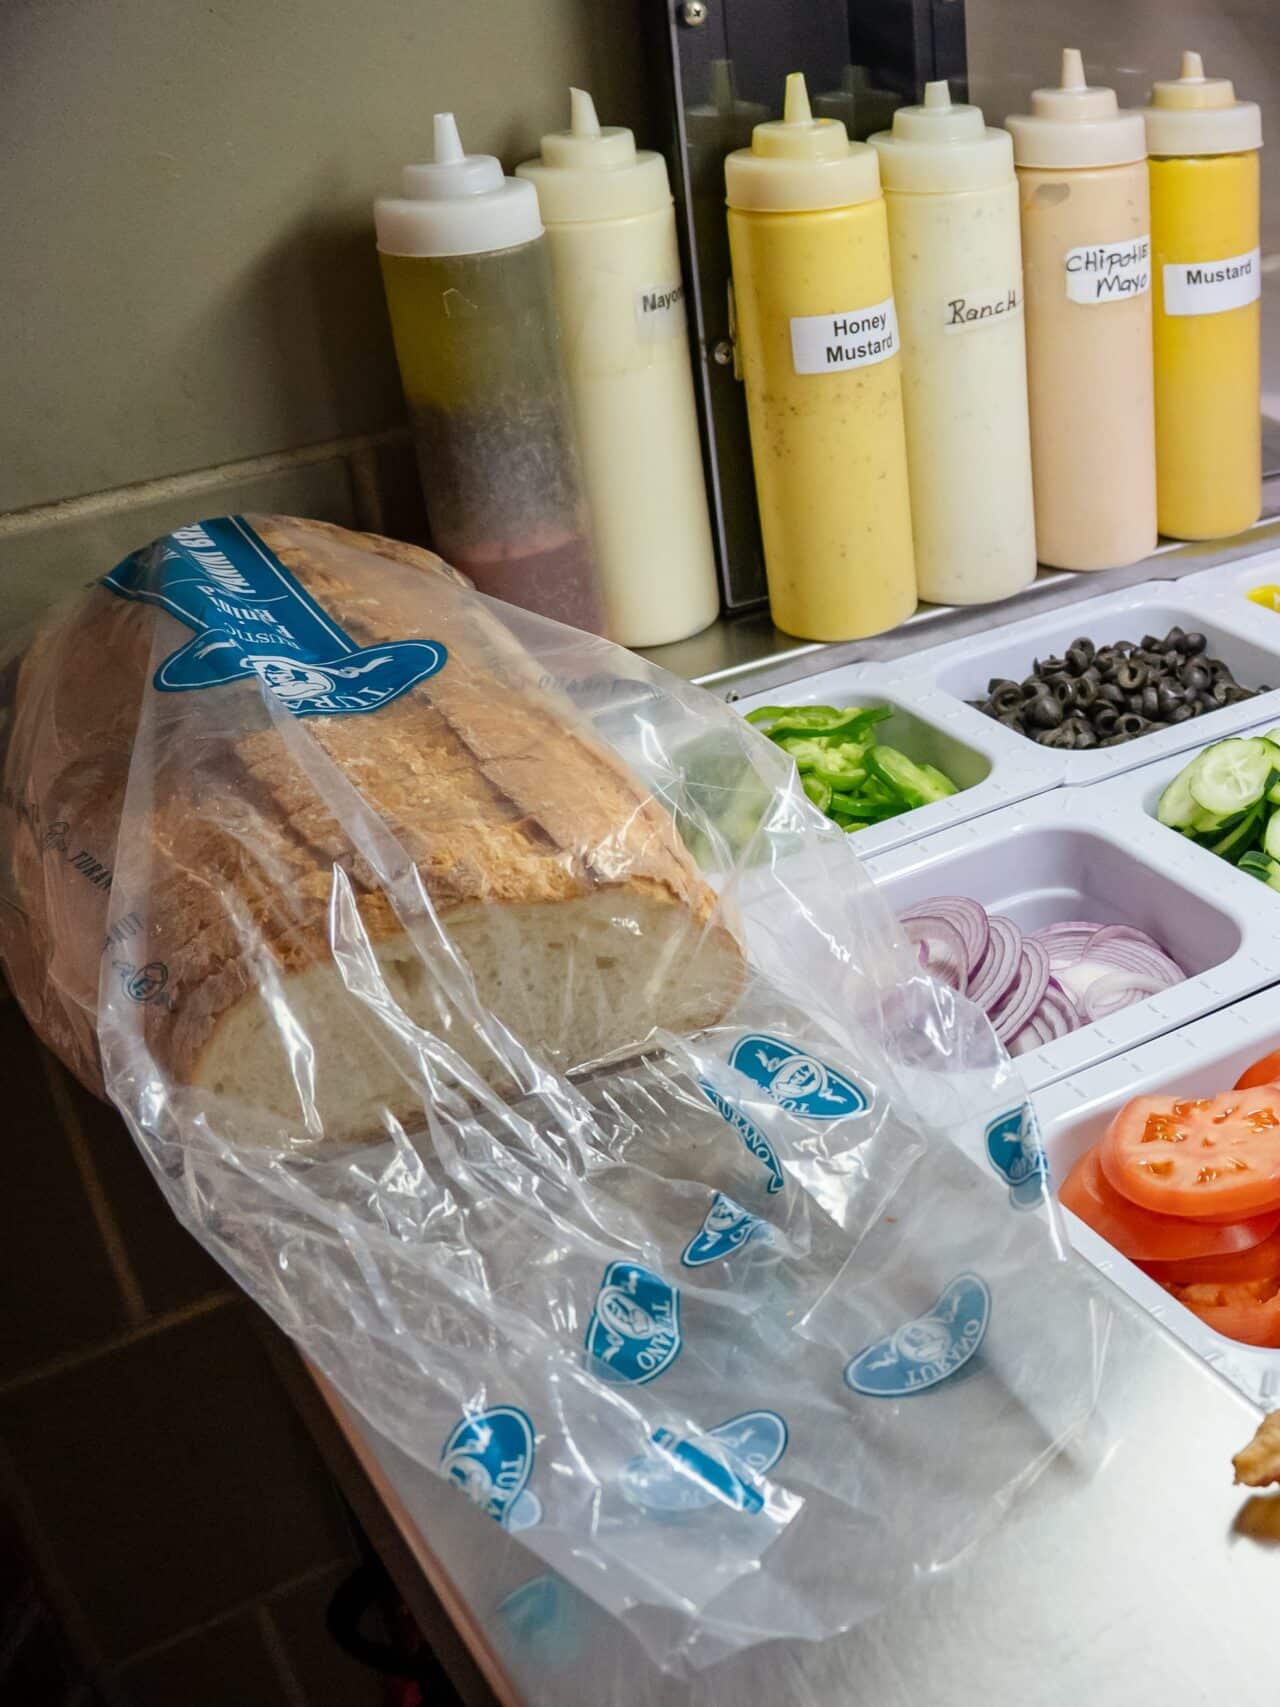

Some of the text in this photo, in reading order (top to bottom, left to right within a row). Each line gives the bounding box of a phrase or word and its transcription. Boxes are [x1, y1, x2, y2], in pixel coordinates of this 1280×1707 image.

[1096, 273, 1148, 299] Mayo
[1186, 261, 1252, 286] Mustard
[833, 312, 887, 337] Honey
[826, 331, 893, 364] Mustard
[282, 686, 396, 710] TURA
